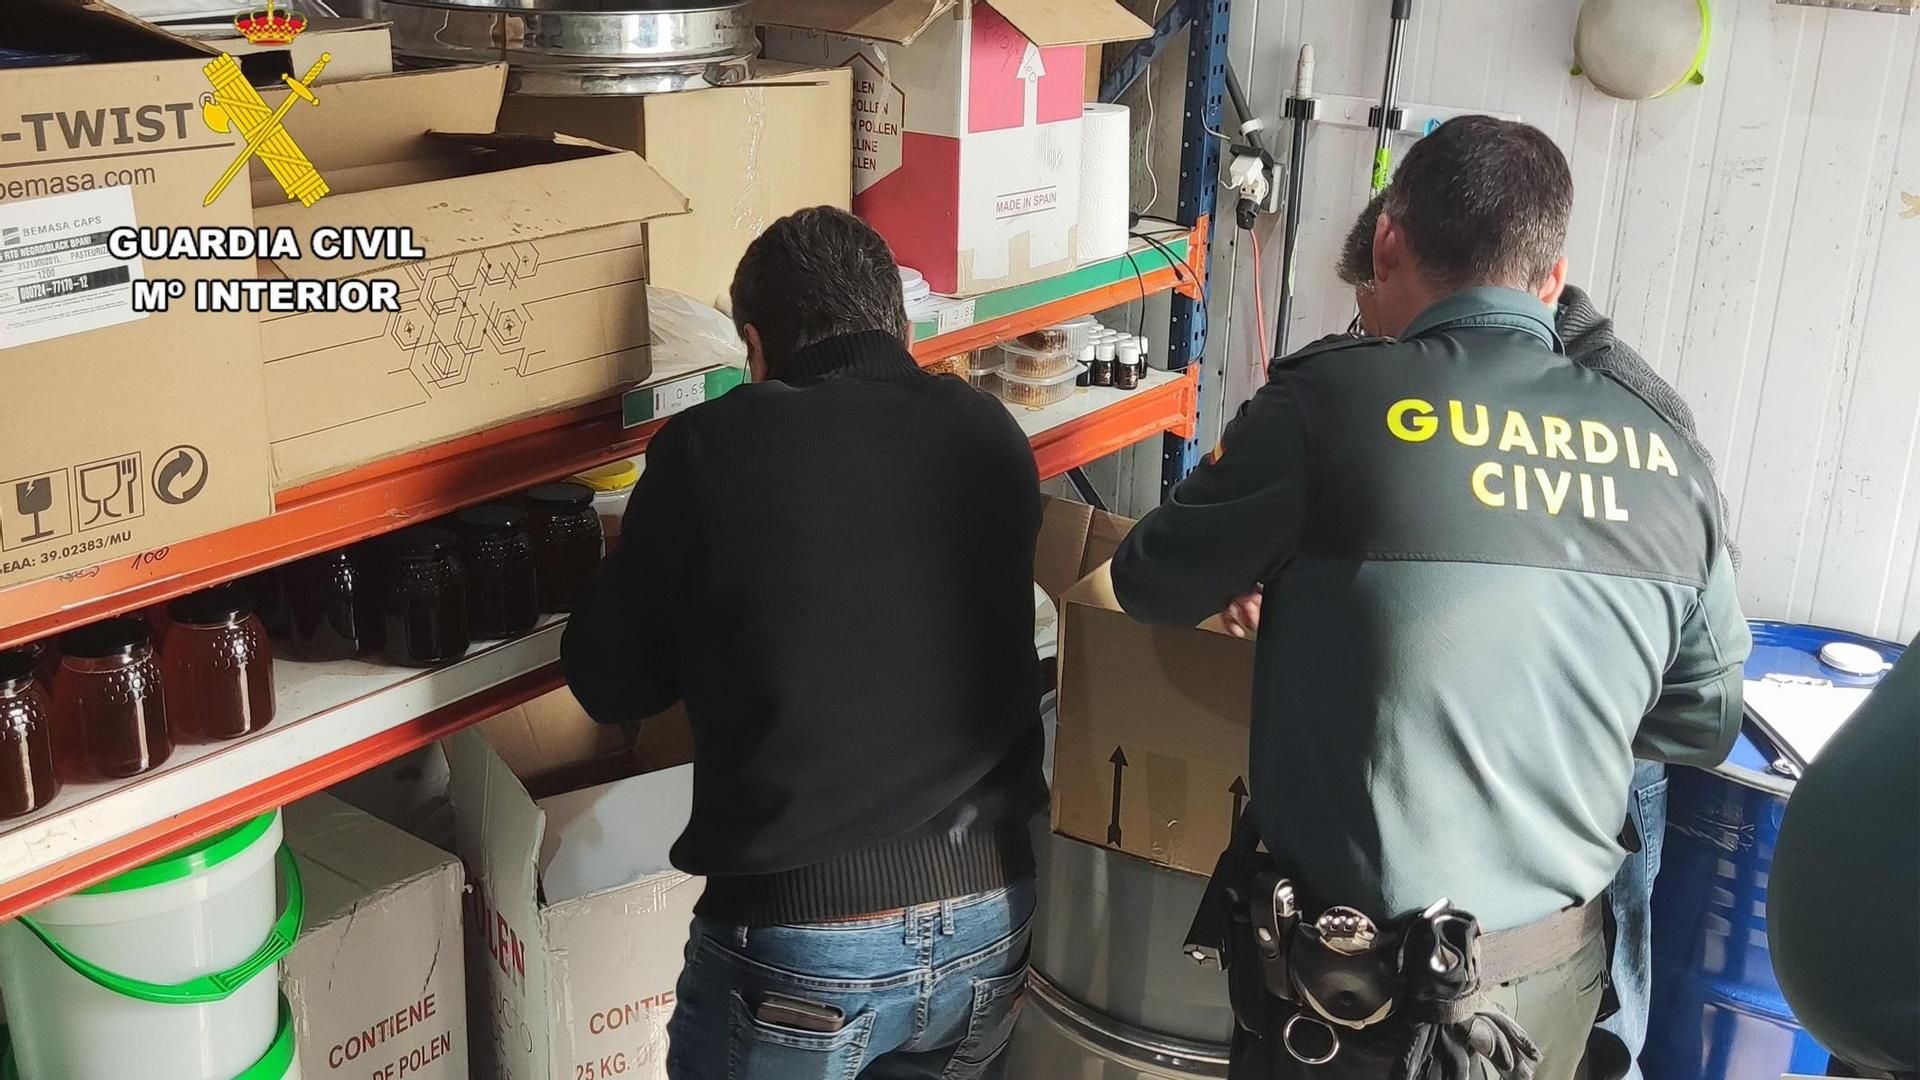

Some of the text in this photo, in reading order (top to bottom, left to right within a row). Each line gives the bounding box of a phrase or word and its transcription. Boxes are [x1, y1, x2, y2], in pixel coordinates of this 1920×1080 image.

[855, 81, 875, 94] LEN
[859, 119, 898, 136] POLLEN
[996, 191, 1057, 214] MADE IN SPAIN
[23, 215, 102, 237] BEMASA CAPS
[70, 245, 109, 261] PASTEURIZ
[1386, 398, 1679, 477] GUARDIA
[1471, 461, 1629, 522] CIVIL
[0, 557, 36, 575] EAA:
[40, 530, 132, 564] 39.02383/MU
[328, 993, 436, 1069] CONTIENE
[588, 990, 675, 1036] CONTIE
[399, 1031, 451, 1079] POLEN
[576, 1060, 595, 1080] 25
[600, 1052, 631, 1079] KG.
